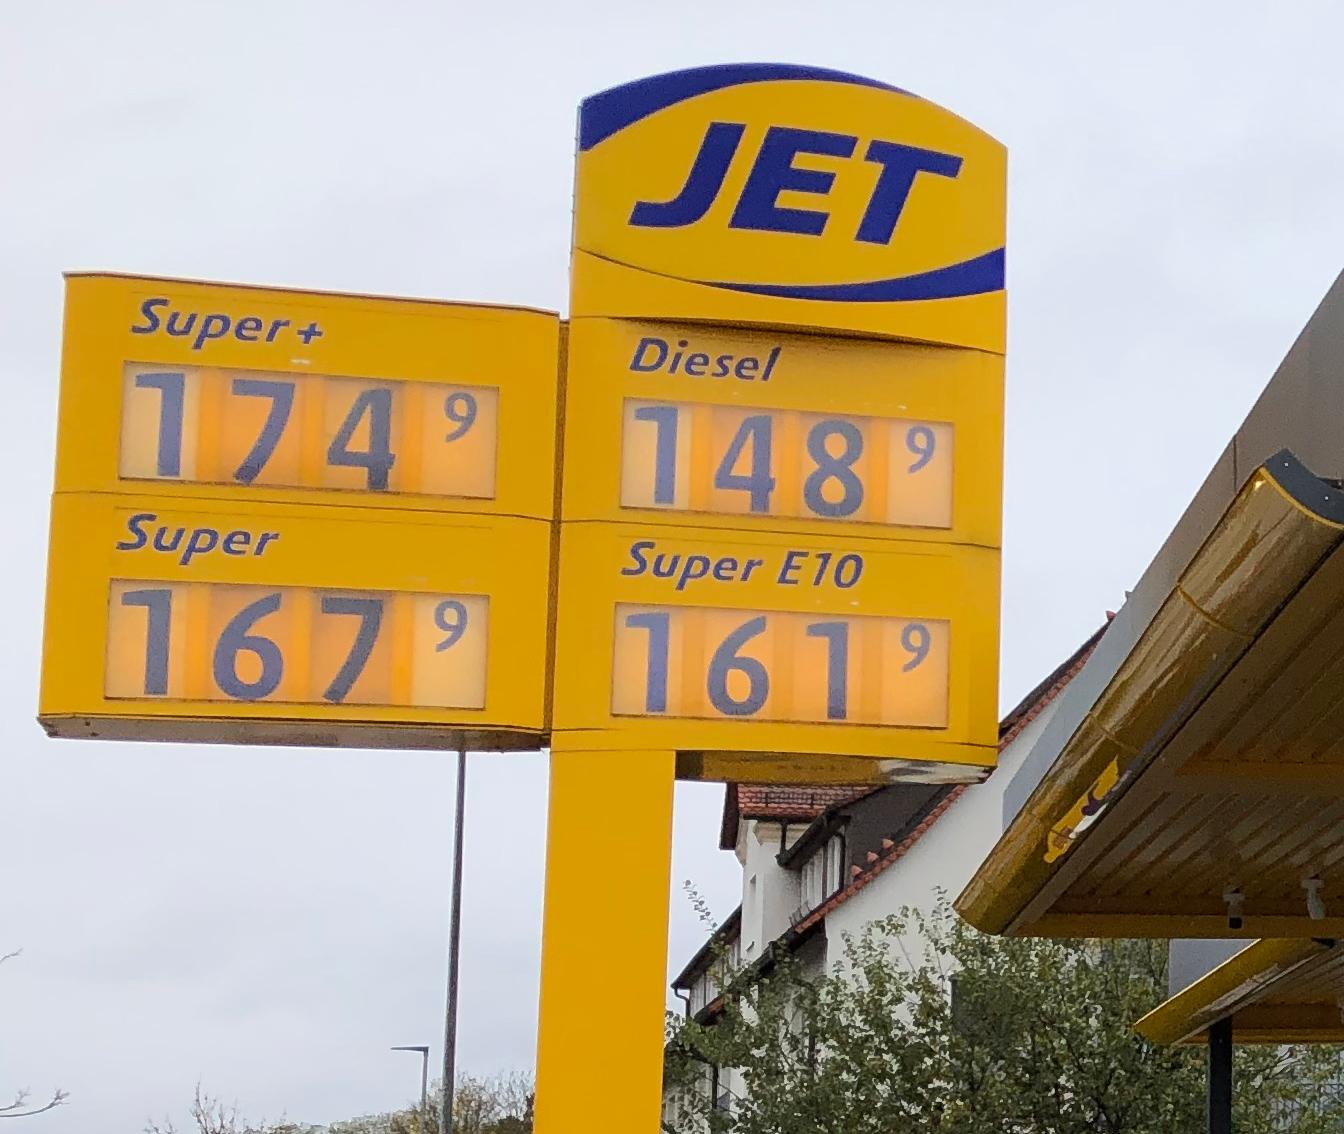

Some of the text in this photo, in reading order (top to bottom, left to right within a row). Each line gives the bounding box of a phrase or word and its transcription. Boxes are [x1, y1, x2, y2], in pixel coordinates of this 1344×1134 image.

[628, 122, 964, 245] JET
[131, 297, 325, 348] Super+
[628, 336, 781, 384] Diesel
[115, 512, 280, 563] Super
[620, 540, 864, 592] Super E10
